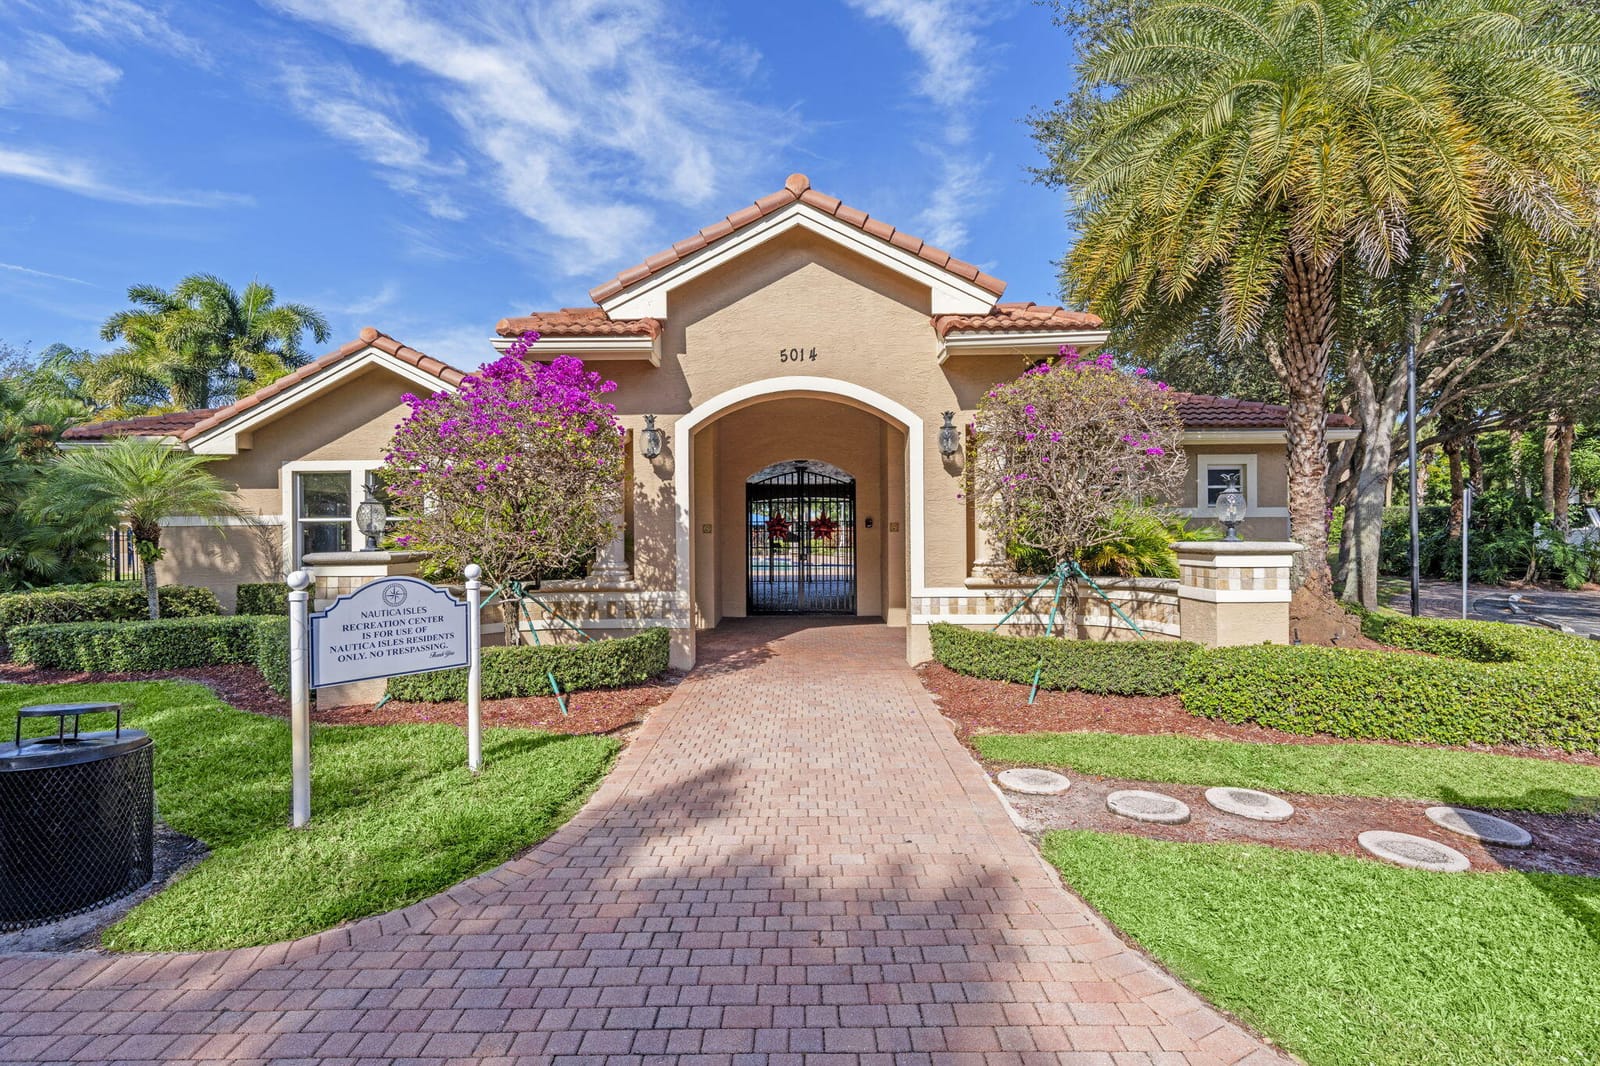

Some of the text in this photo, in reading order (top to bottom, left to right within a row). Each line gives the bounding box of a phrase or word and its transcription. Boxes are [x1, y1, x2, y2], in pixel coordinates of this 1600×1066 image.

[780, 347, 818, 363] 5014
[361, 606, 428, 619] NAUTICA ISLES
[342, 615, 445, 632] RECREATION CENTER
[362, 626, 428, 640] IS FOR USE OF
[329, 632, 455, 654] NAUTICA ISLES RESIDENTS
[337, 642, 449, 663] ONLY. NO TRESPASSING.
